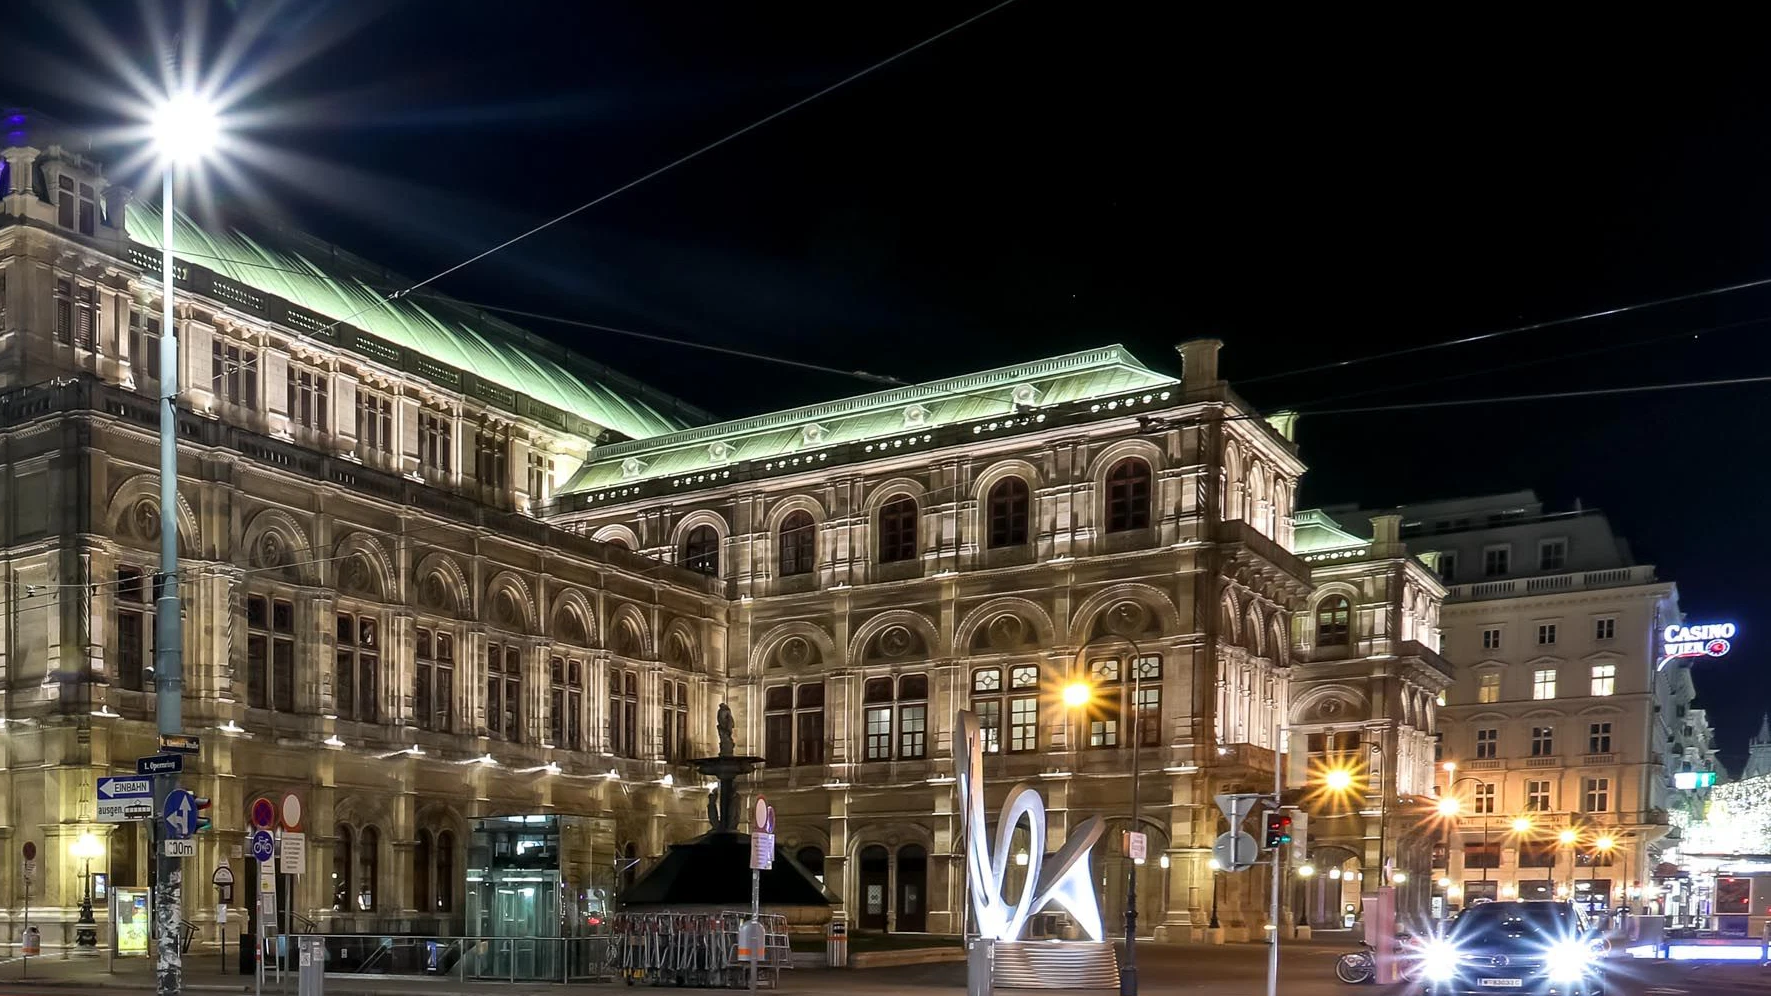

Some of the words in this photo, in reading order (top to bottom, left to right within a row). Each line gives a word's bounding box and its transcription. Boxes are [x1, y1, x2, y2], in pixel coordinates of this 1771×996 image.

[1663, 622, 1736, 642] CASINO
[1663, 641, 1706, 655] WIEN
[114, 782, 147, 793] EINBAHN
[98, 805, 124, 817] ausgen.
